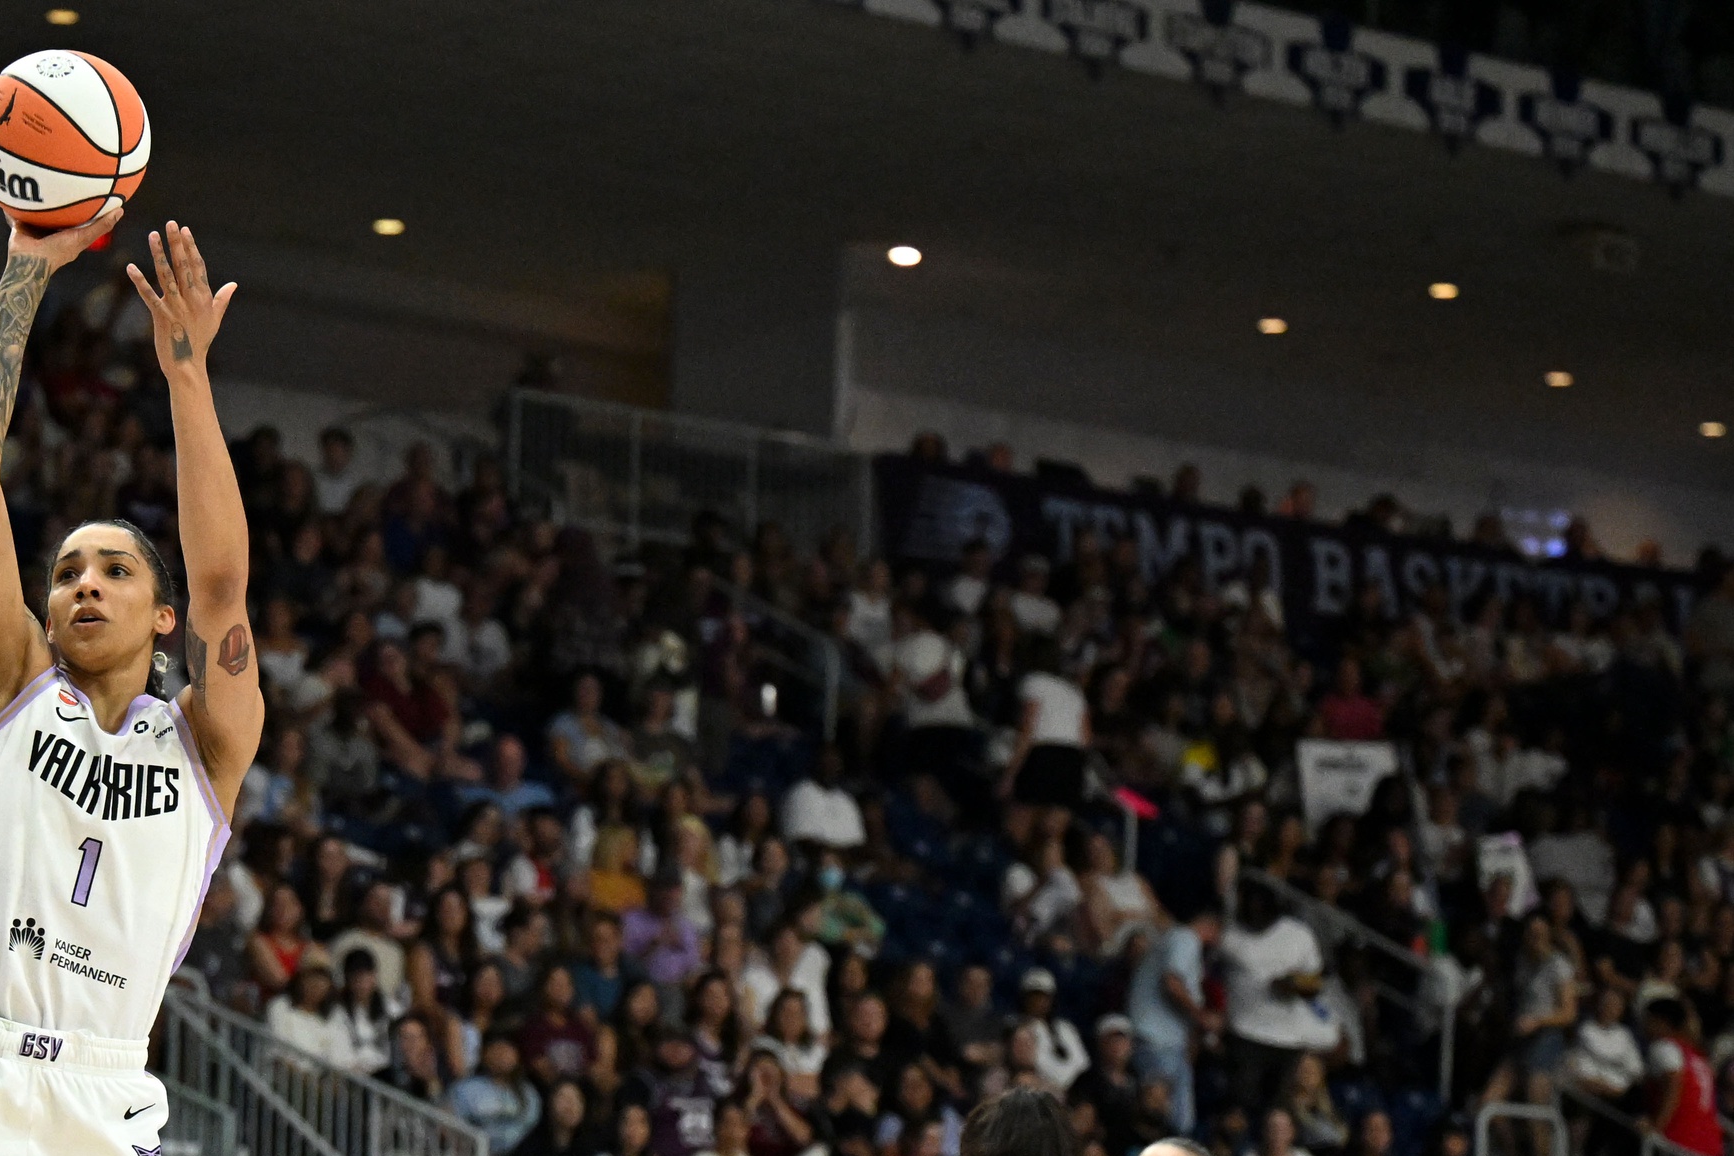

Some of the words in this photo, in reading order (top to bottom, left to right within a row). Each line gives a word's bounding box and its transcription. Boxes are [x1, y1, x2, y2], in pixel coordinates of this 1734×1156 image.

[28, 730, 179, 821] VALKYRIES
[71, 837, 103, 907] 1
[54, 938, 92, 961] KAISER
[49, 953, 127, 989] PERMANENTE
[19, 1032, 64, 1062] GSV
